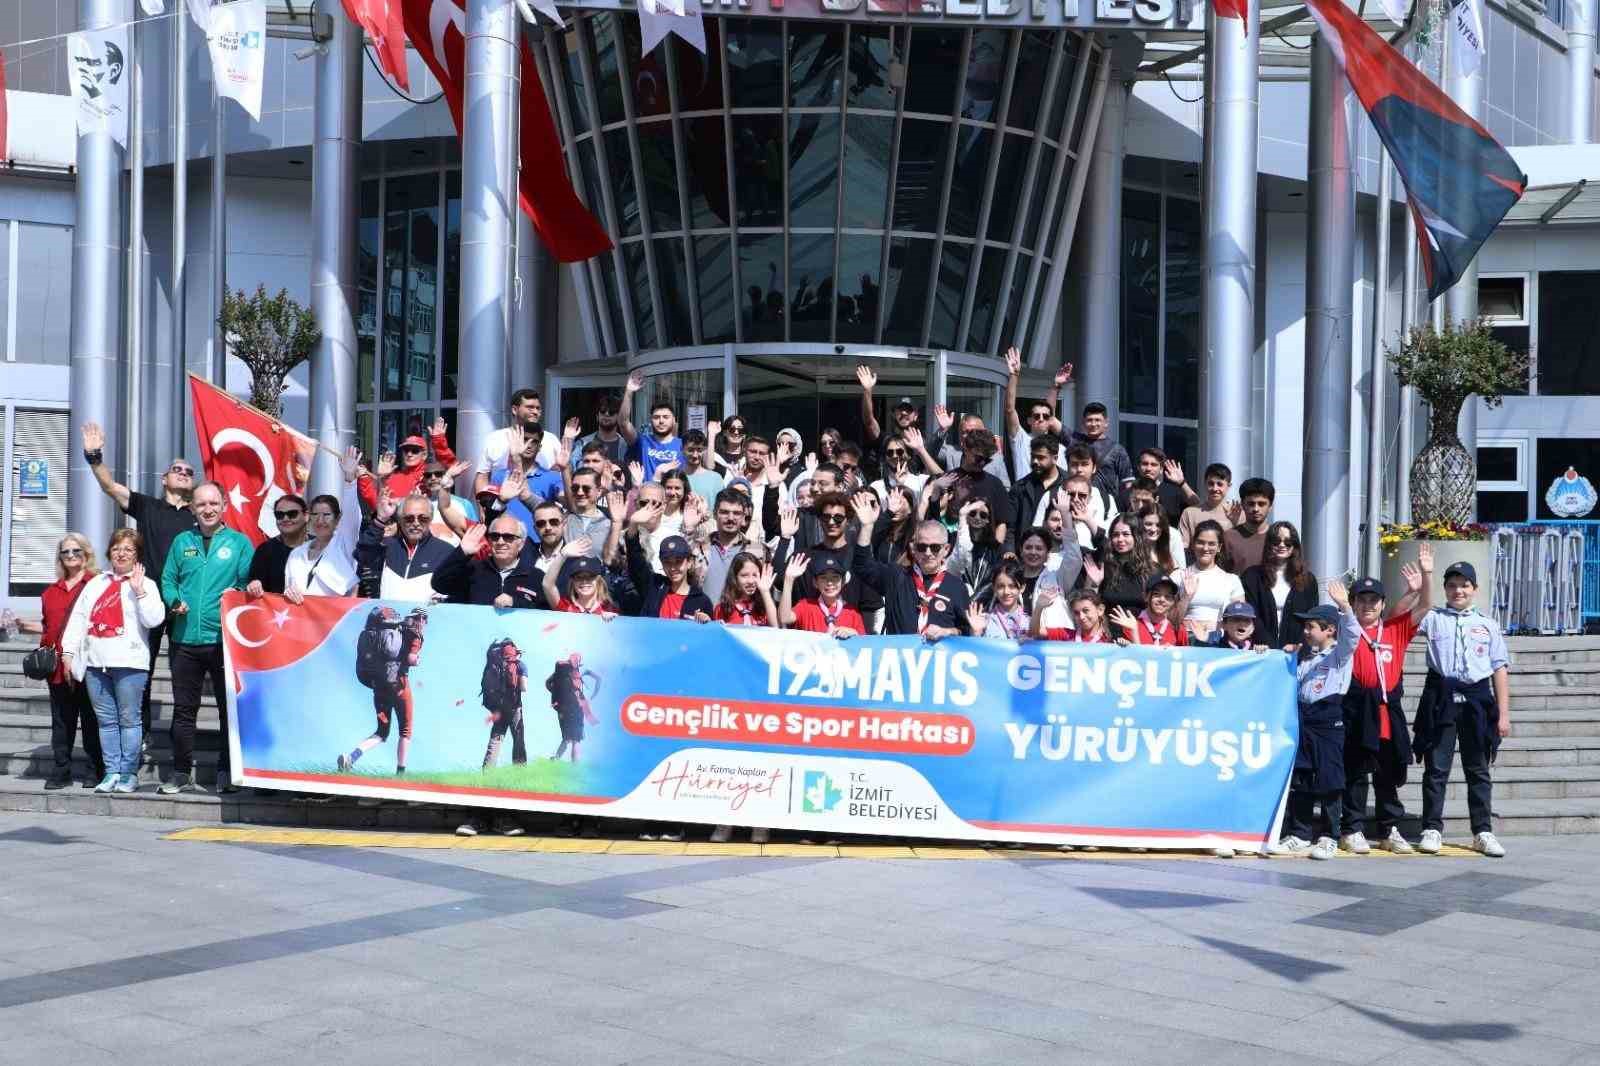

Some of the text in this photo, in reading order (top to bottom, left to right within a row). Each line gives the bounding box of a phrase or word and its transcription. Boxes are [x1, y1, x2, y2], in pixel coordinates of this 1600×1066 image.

[1006, 652, 1217, 709] GENÇLİK
[626, 700, 970, 745] Gençlik ve Spor Haftası
[1004, 714, 1272, 781] YÜRÜYÜŞÜ
[849, 784, 893, 802] İZMİT
[849, 803, 937, 821] BELEDİYESİ
